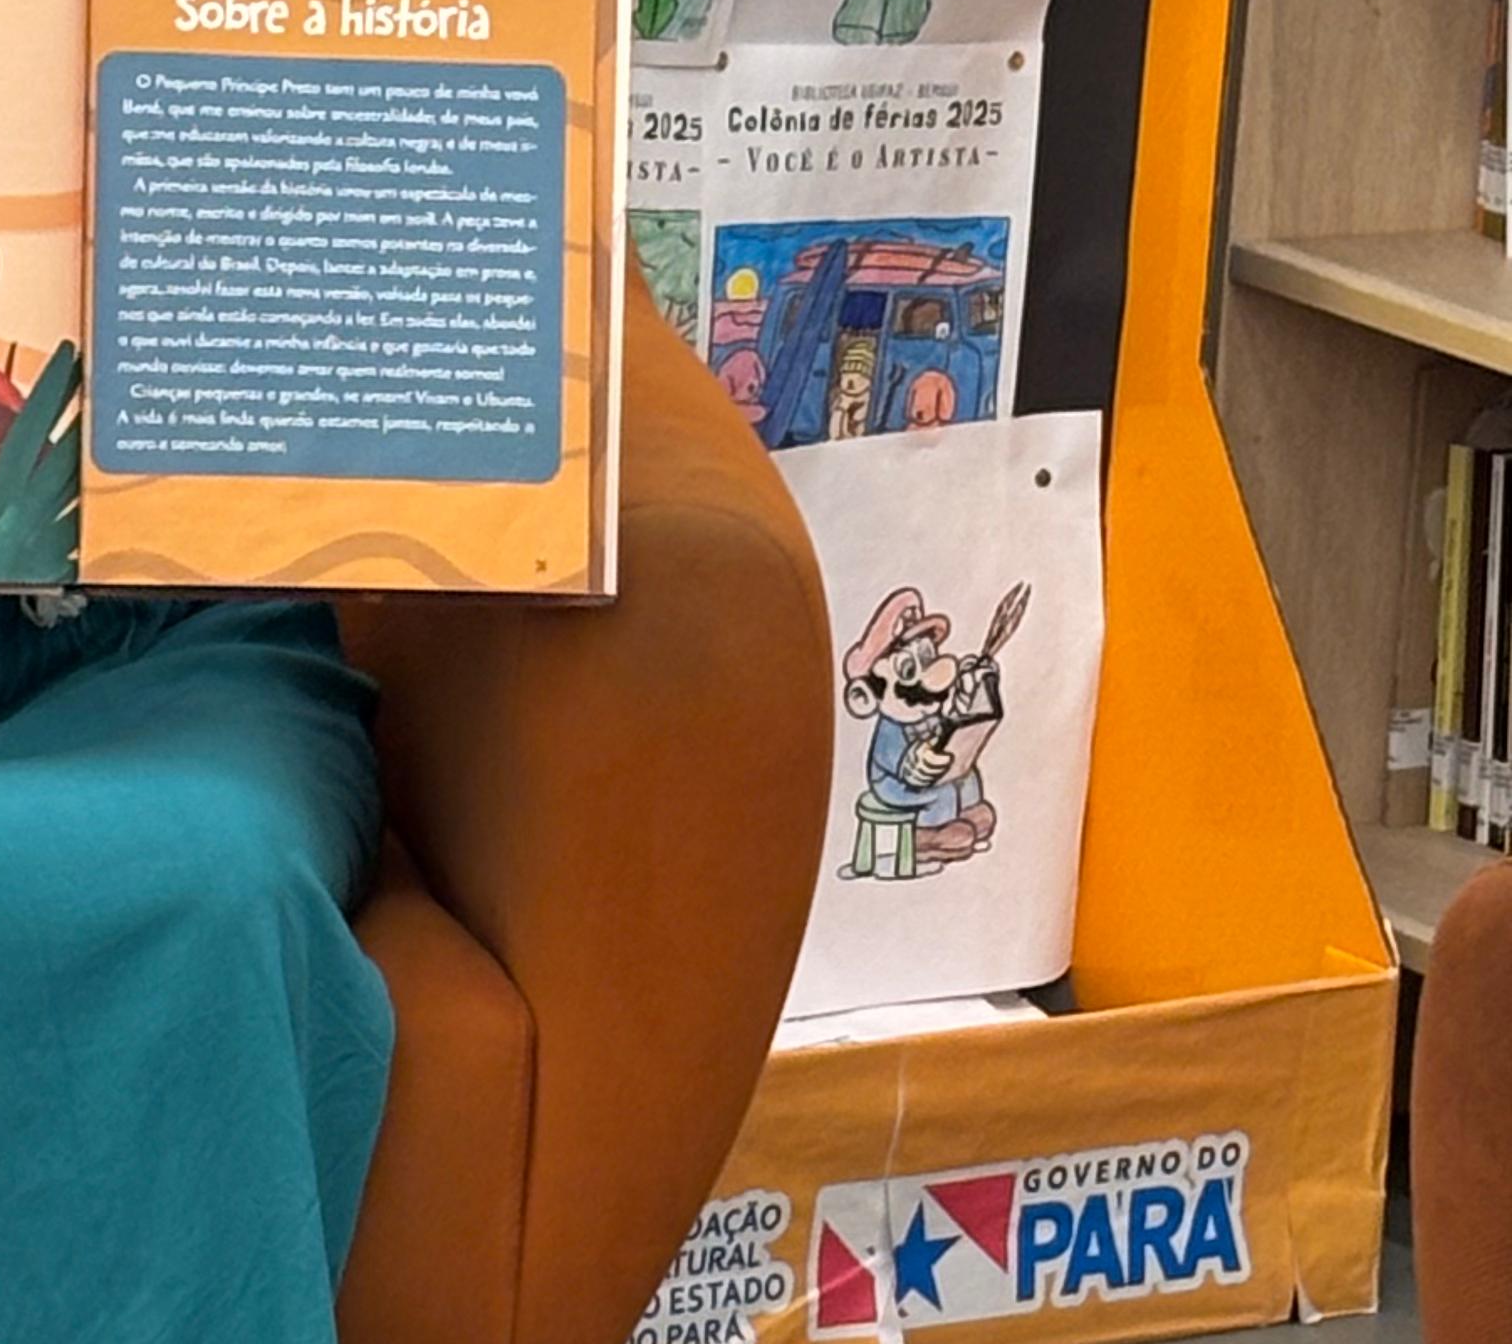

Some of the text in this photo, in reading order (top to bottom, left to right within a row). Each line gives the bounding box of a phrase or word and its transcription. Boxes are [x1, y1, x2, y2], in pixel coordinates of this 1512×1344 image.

[303, 0, 326, 35] a
[136, 74, 151, 88] O
[434, 82, 453, 98] de
[791, 85, 857, 101] BIBLIOTECA
[642, 113, 703, 141] 2025
[727, 100, 1003, 133] Colônia de férias 2025
[747, 146, 813, 173] VOCÊ
[133, 177, 147, 193] A
[442, 211, 454, 226] A
[1023, 1142, 1241, 1193] GOVERNO DO
[1016, 1177, 1241, 1302] PARÁ
[664, 1241, 761, 1278] TURAL
[670, 1273, 785, 1315] ESTADO
